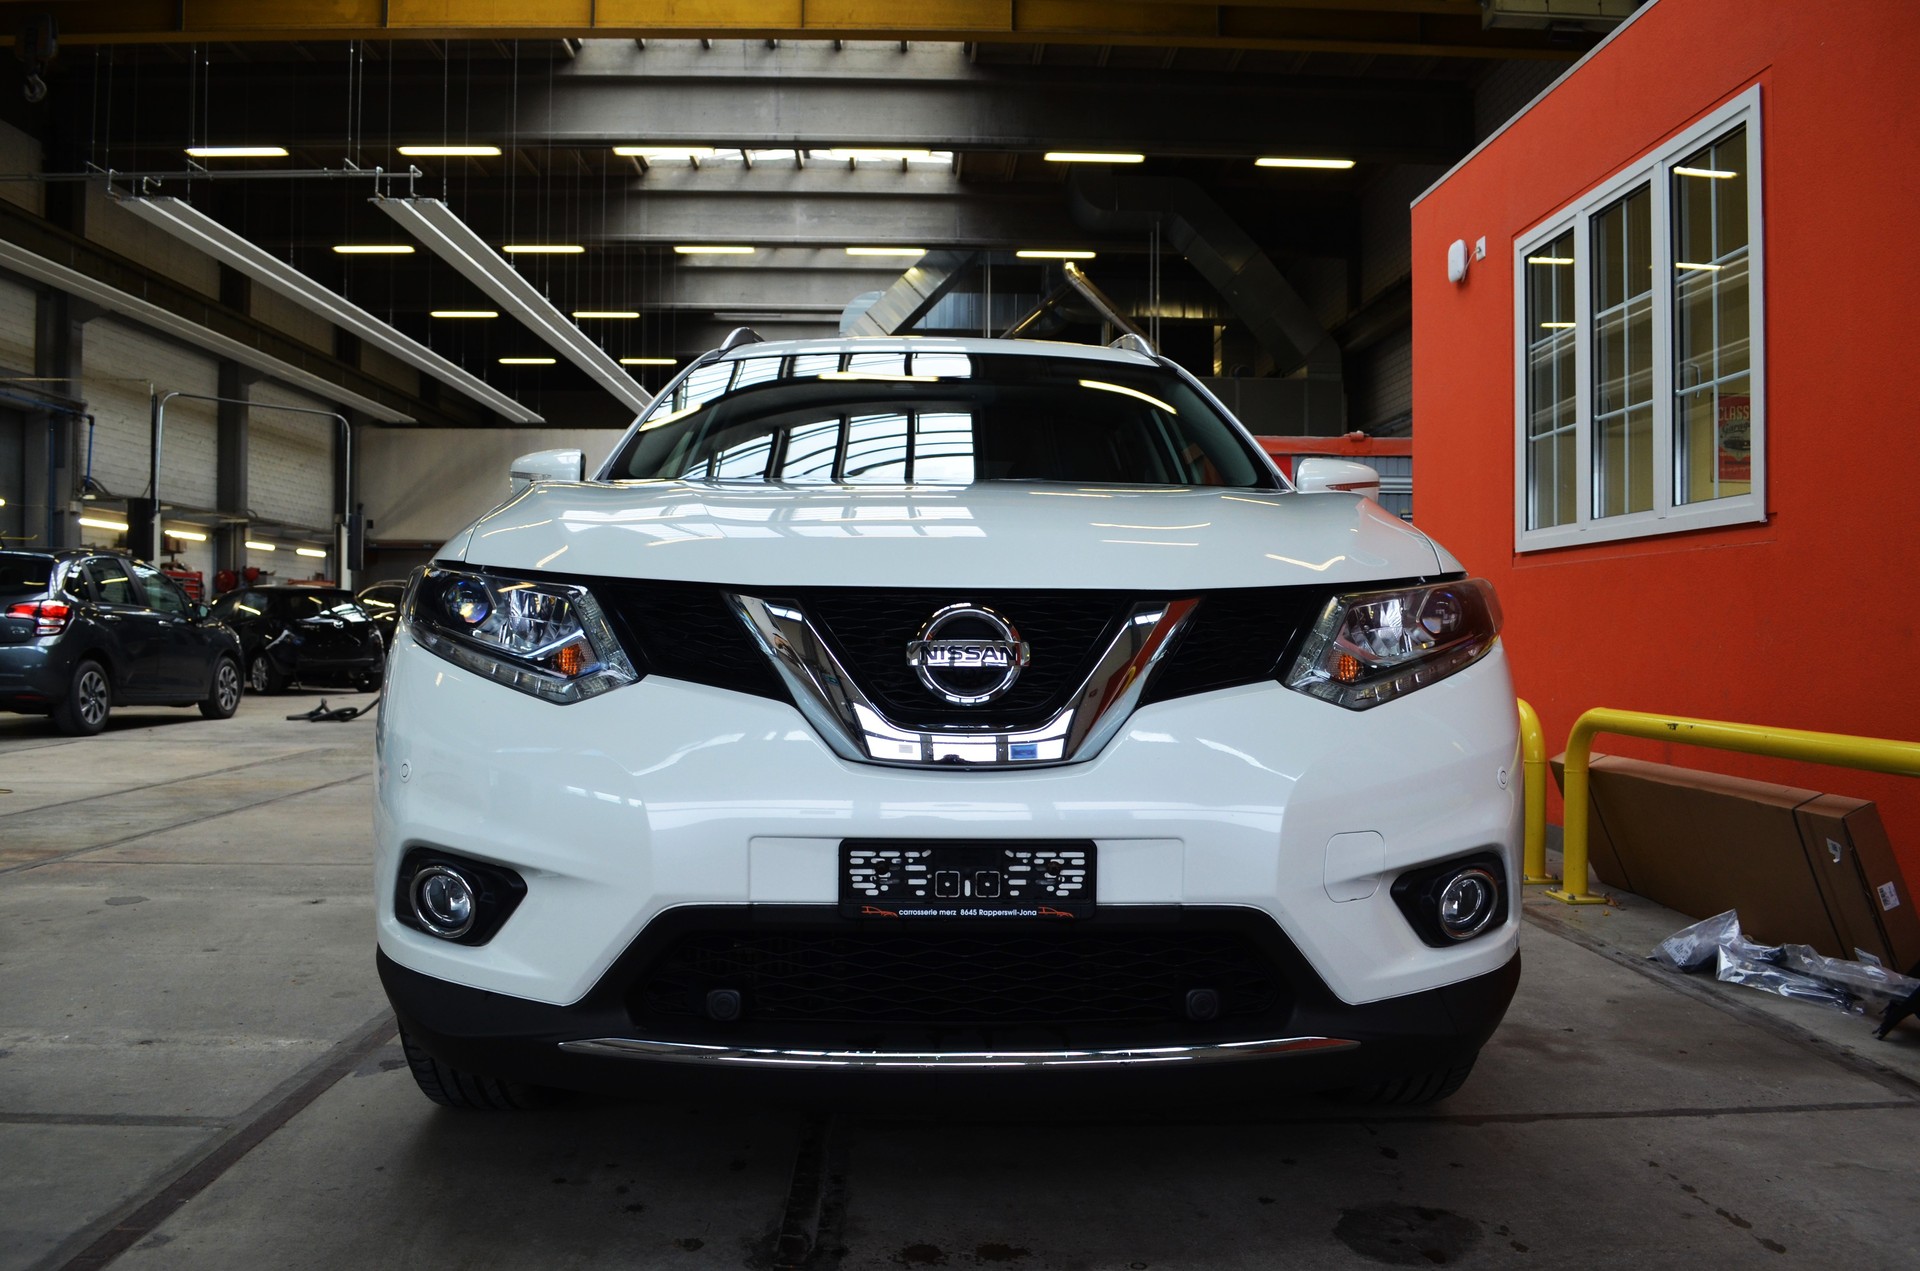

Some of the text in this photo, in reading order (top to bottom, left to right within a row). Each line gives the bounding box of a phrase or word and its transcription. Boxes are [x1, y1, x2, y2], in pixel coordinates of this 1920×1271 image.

[920, 645, 1017, 661] NISSAN
[898, 908, 1037, 917] carrosserie merz 8645 Rapperswil-Jona
